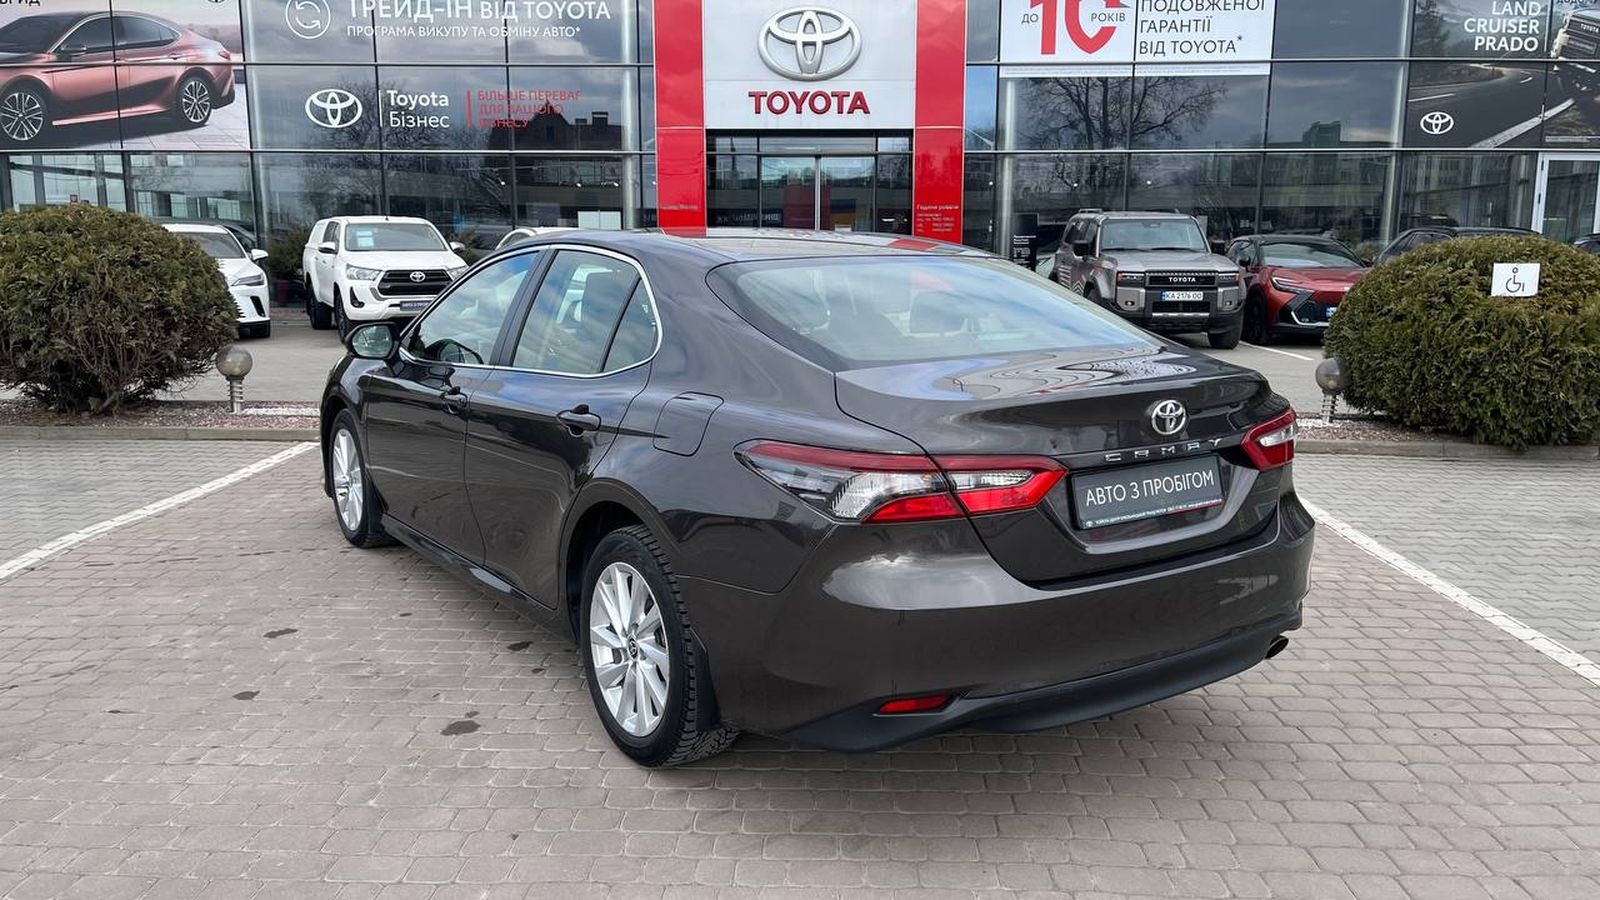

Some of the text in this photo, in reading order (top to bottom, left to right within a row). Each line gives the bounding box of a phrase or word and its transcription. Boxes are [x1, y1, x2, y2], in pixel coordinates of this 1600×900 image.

[480, 1, 518, 23] ВІД
[523, 2, 611, 19] TOYOTA
[1491, 1, 1541, 16] LAND
[1021, 14, 1039, 24] ДО
[1090, 12, 1126, 22] РОКІВ
[1140, 15, 1213, 33] ГАРАНТІЇ
[1463, 18, 1540, 34] CRUISER
[347, 25, 415, 37] ПРОГРАМА
[418, 26, 469, 37] ВИКУПУ
[472, 27, 486, 37] ТА
[489, 26, 540, 37] ОБМІНУ
[1139, 40, 1166, 57] ВІД
[1474, 36, 1539, 52] PRADO
[387, 90, 449, 110] Toyota
[478, 90, 525, 101] БІЛЬШЕ
[748, 91, 870, 115] TOYOTA
[389, 111, 450, 129] Бізнес
[1105, 438, 1222, 461] CAMRY
[1086, 485, 1127, 507] АВТО
[1142, 470, 1215, 497] ПРОБІГОМ
